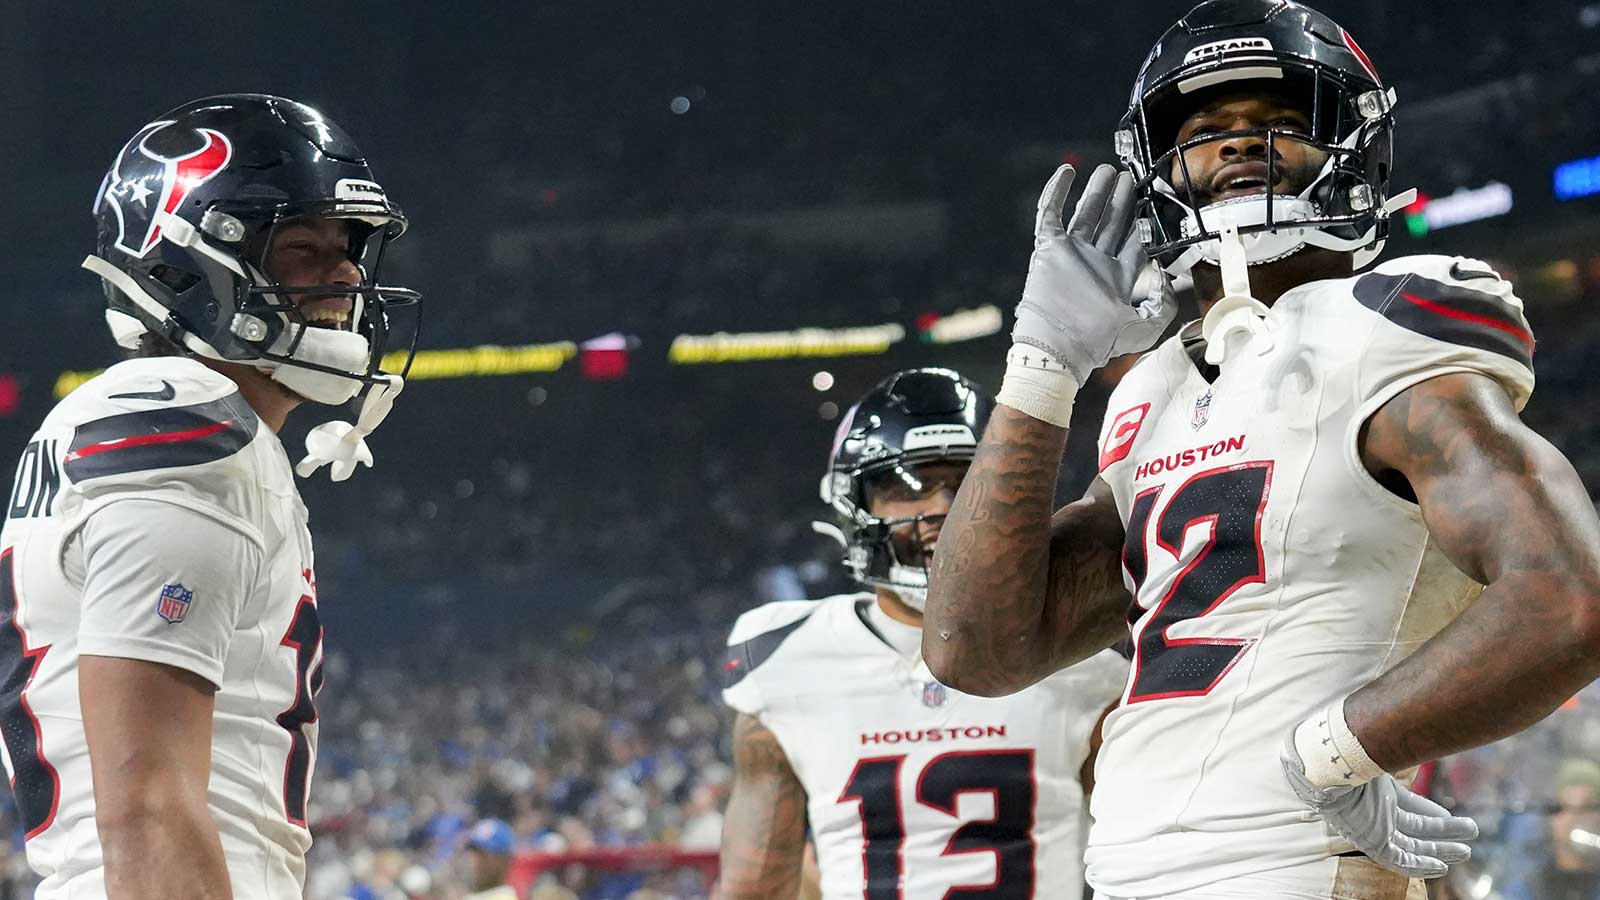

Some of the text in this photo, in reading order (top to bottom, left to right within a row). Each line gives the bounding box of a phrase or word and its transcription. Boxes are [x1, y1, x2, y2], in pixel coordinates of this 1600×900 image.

[1192, 40, 1265, 57] TEXANS
[346, 183, 385, 196] TEX
[1105, 407, 1144, 453] C
[9, 439, 61, 519] ON
[1134, 434, 1247, 482] HOUSTON
[1122, 459, 1275, 705] 12
[160, 596, 188, 622] NFL
[860, 724, 1008, 745] HOUSTON
[835, 748, 1038, 900] 13
